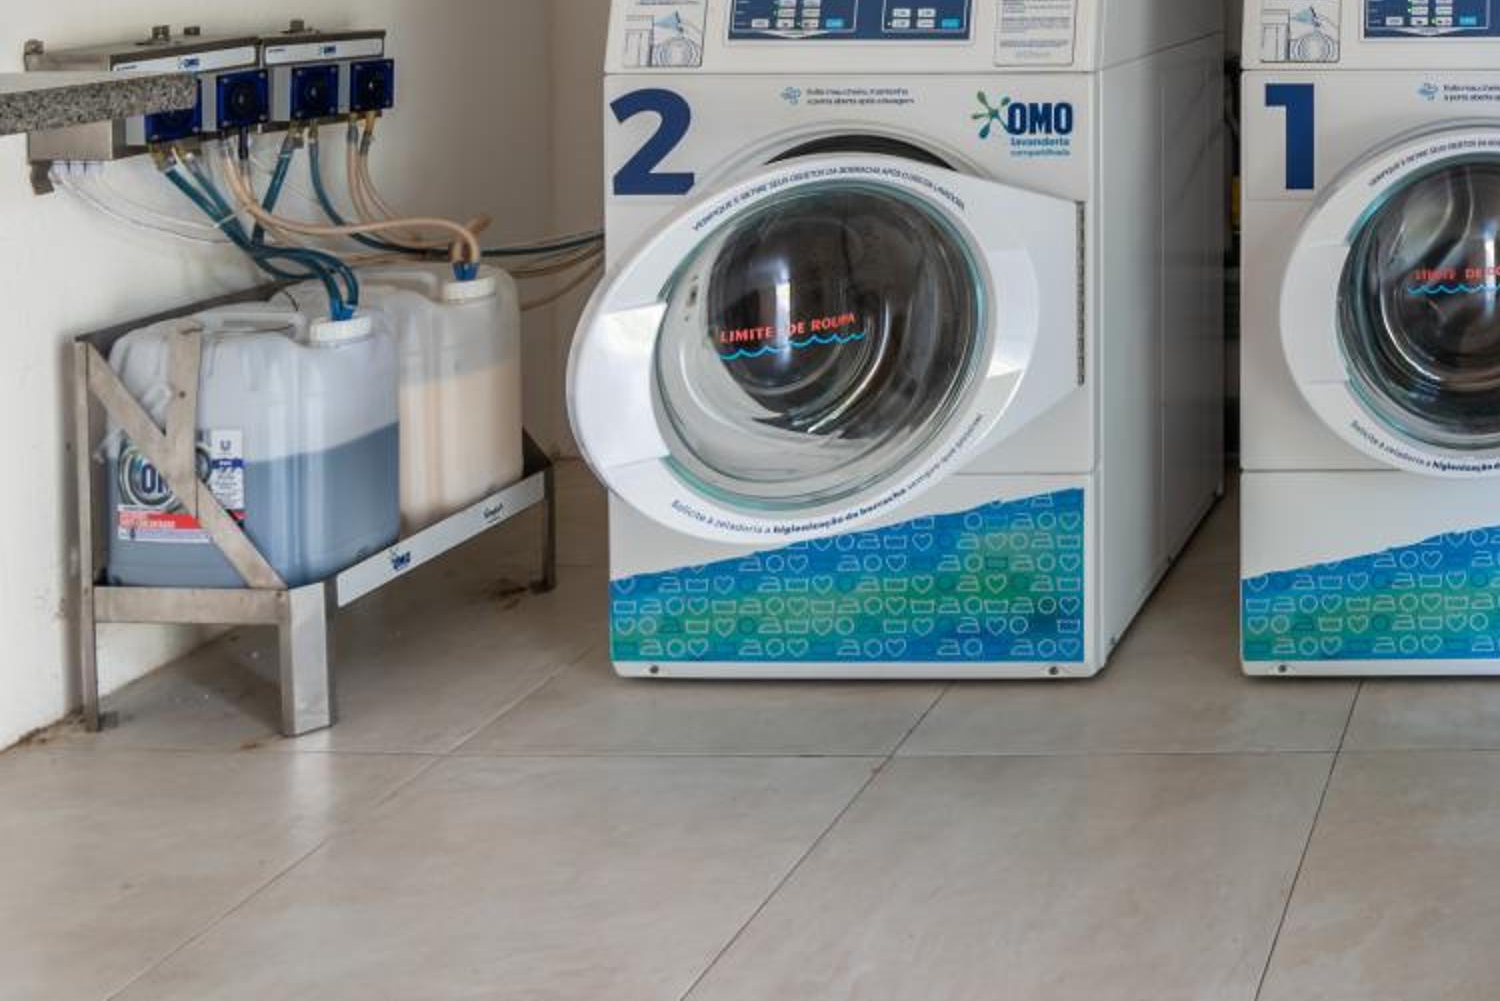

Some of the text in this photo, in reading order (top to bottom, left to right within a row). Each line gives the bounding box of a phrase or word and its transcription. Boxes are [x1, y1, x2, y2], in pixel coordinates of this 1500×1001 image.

[1007, 102, 1072, 135] OMO
[610, 88, 694, 195] 2
[1010, 136, 1070, 147] lavanderia
[1265, 83, 1315, 190] 1
[719, 312, 856, 344] LIMITE DE ROUPA
[773, 515, 844, 536] higienização
